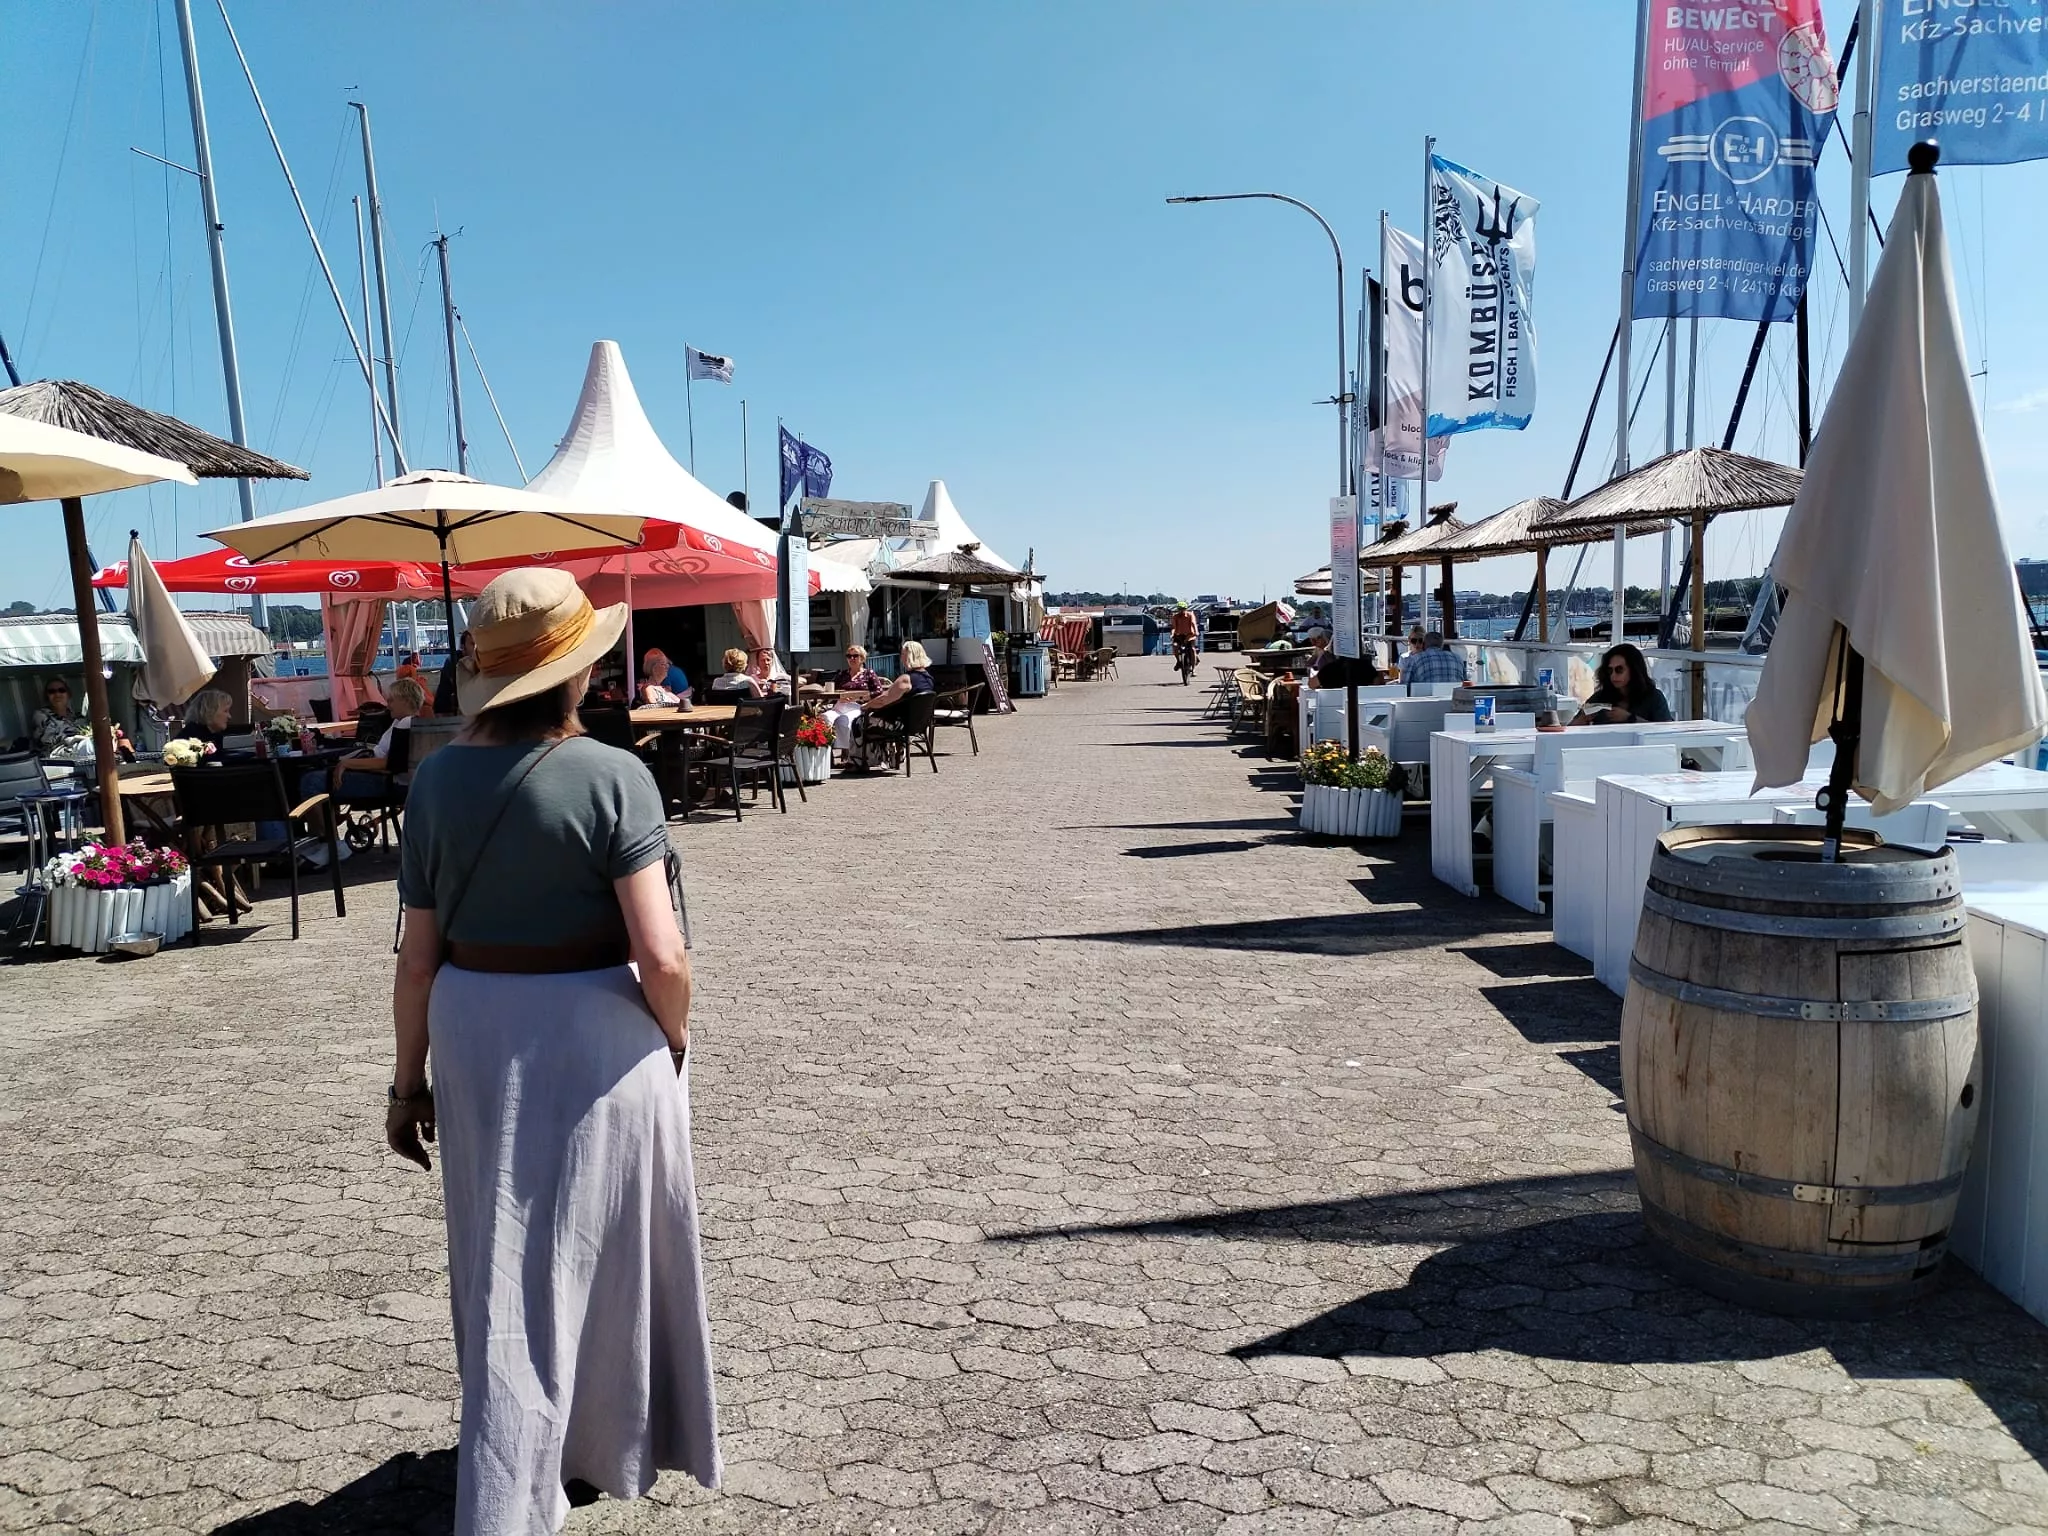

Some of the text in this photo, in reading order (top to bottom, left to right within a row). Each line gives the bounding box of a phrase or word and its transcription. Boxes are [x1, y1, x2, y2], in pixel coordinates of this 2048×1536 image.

[1666, 6, 1777, 33] BEWEGT
[1664, 37, 1765, 55] HU/AU-Service
[1663, 55, 1750, 73] ohne Termin!
[1896, 107, 1987, 131] Grasweg
[1992, 102, 2031, 124] 2-4
[1653, 190, 1725, 213] ENGEL
[1737, 191, 1816, 218] HARDER
[1652, 215, 1814, 241] Kfz-Sachverständige
[1647, 278, 1705, 294] Grasweg
[1466, 241, 1500, 402] KOMBÜSE
[1508, 310, 1519, 341] BAR
[1505, 356, 1518, 398] FISCH
[1384, 449, 1398, 461] lock
